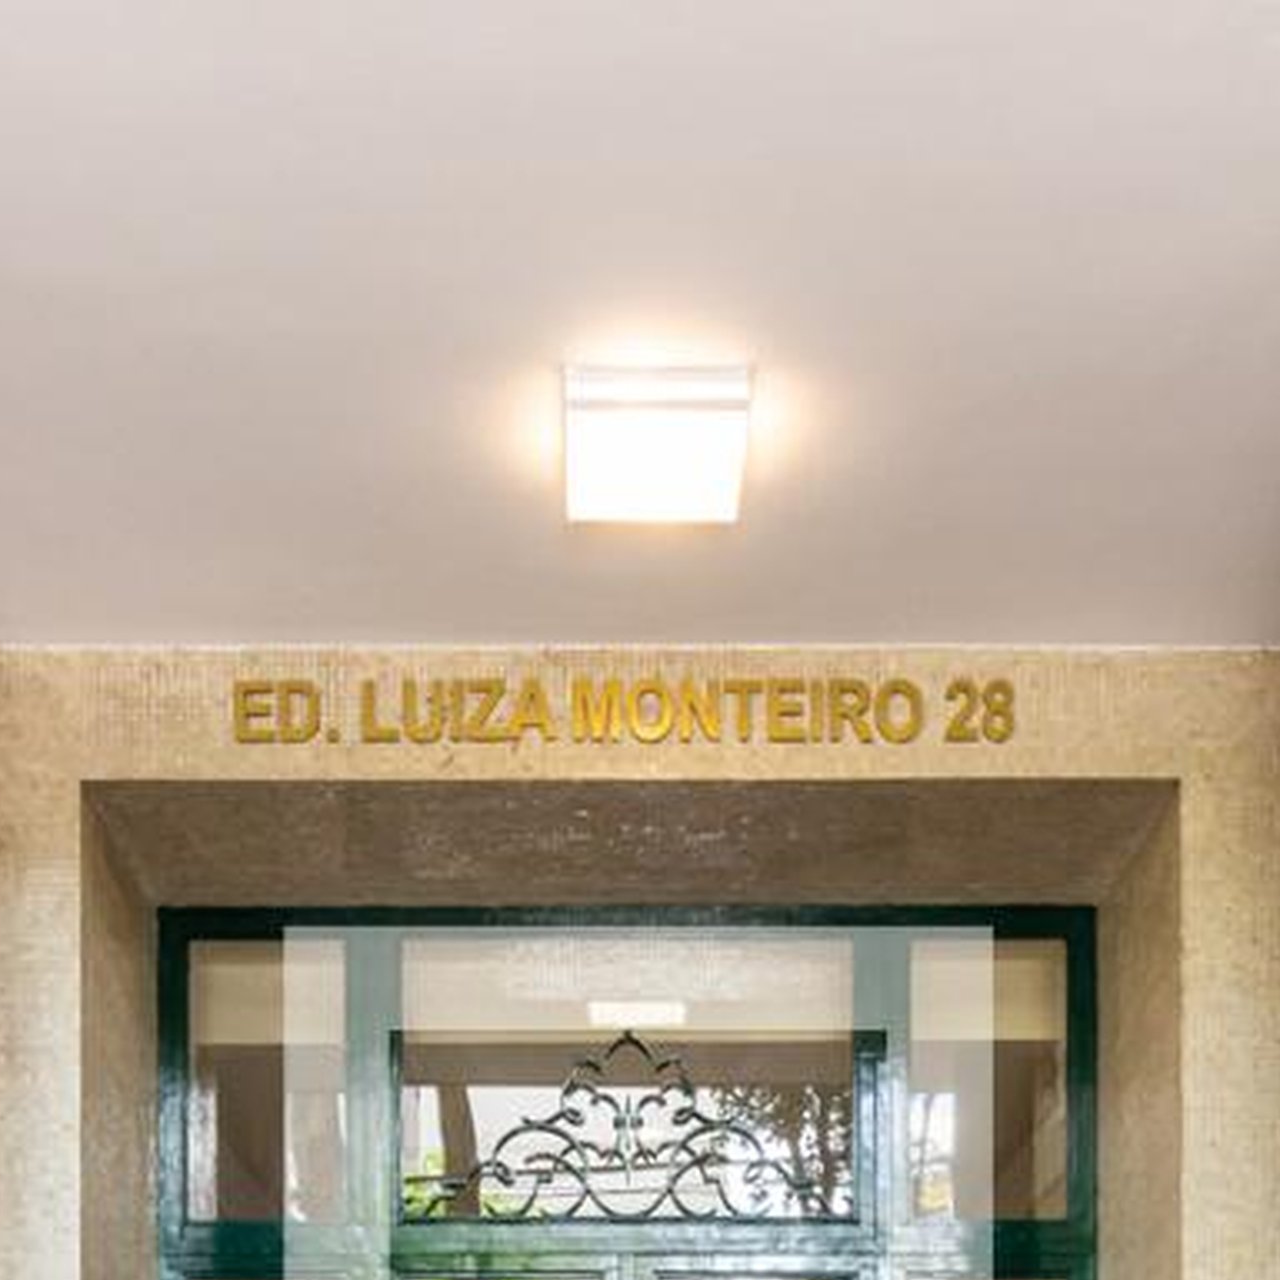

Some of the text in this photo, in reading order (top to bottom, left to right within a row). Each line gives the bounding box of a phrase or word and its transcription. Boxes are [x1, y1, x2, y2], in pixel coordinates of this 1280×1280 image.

[232, 678, 1016, 744] ED. LUIZA MONTEIRO 28
